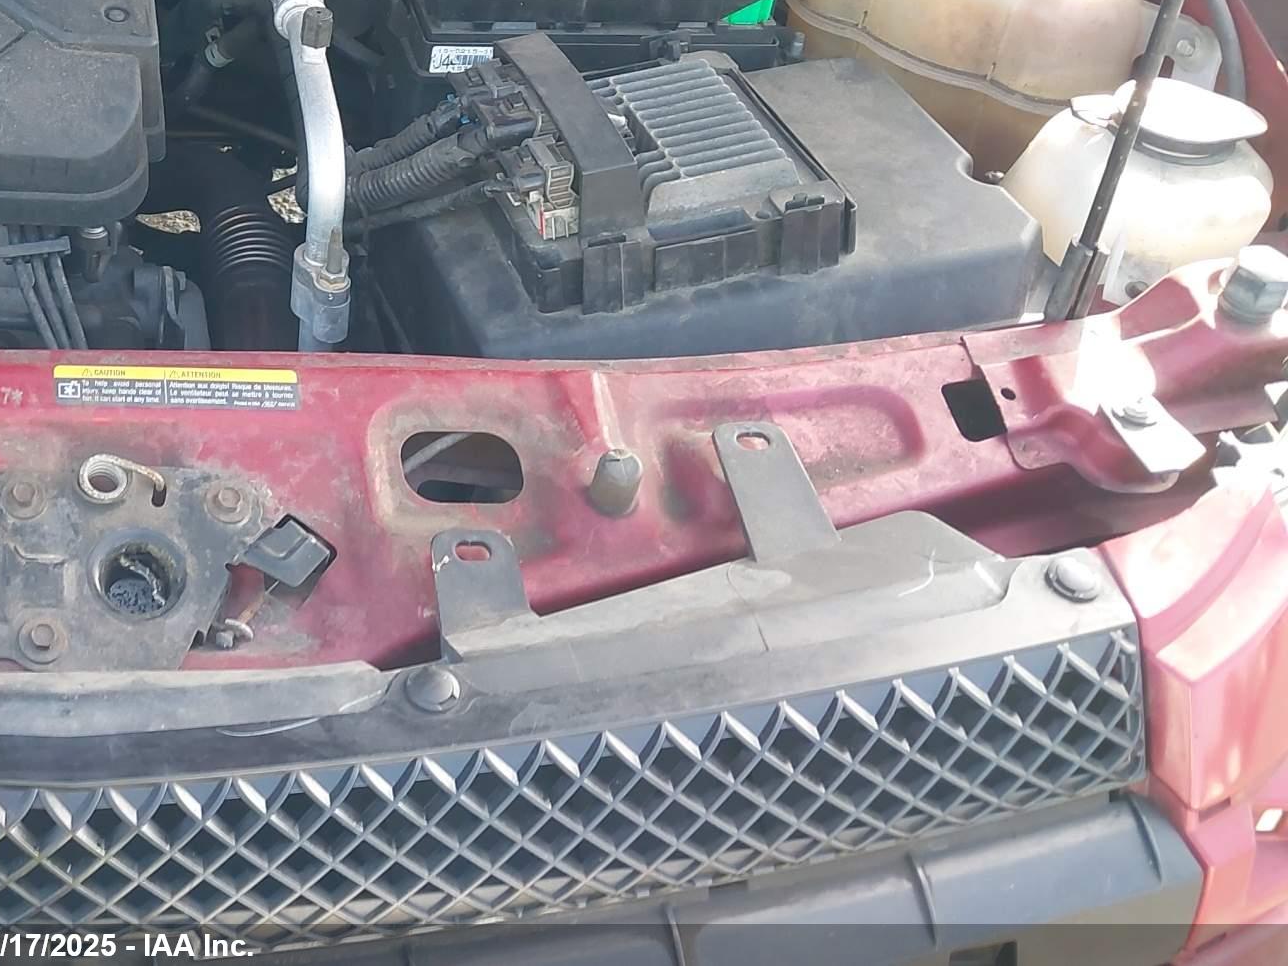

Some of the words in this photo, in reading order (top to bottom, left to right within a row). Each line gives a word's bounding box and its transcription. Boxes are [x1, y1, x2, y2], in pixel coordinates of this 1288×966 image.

[94, 369, 126, 377] CAUTION
[181, 371, 221, 379] ATTENTION
[94, 380, 108, 388] help
